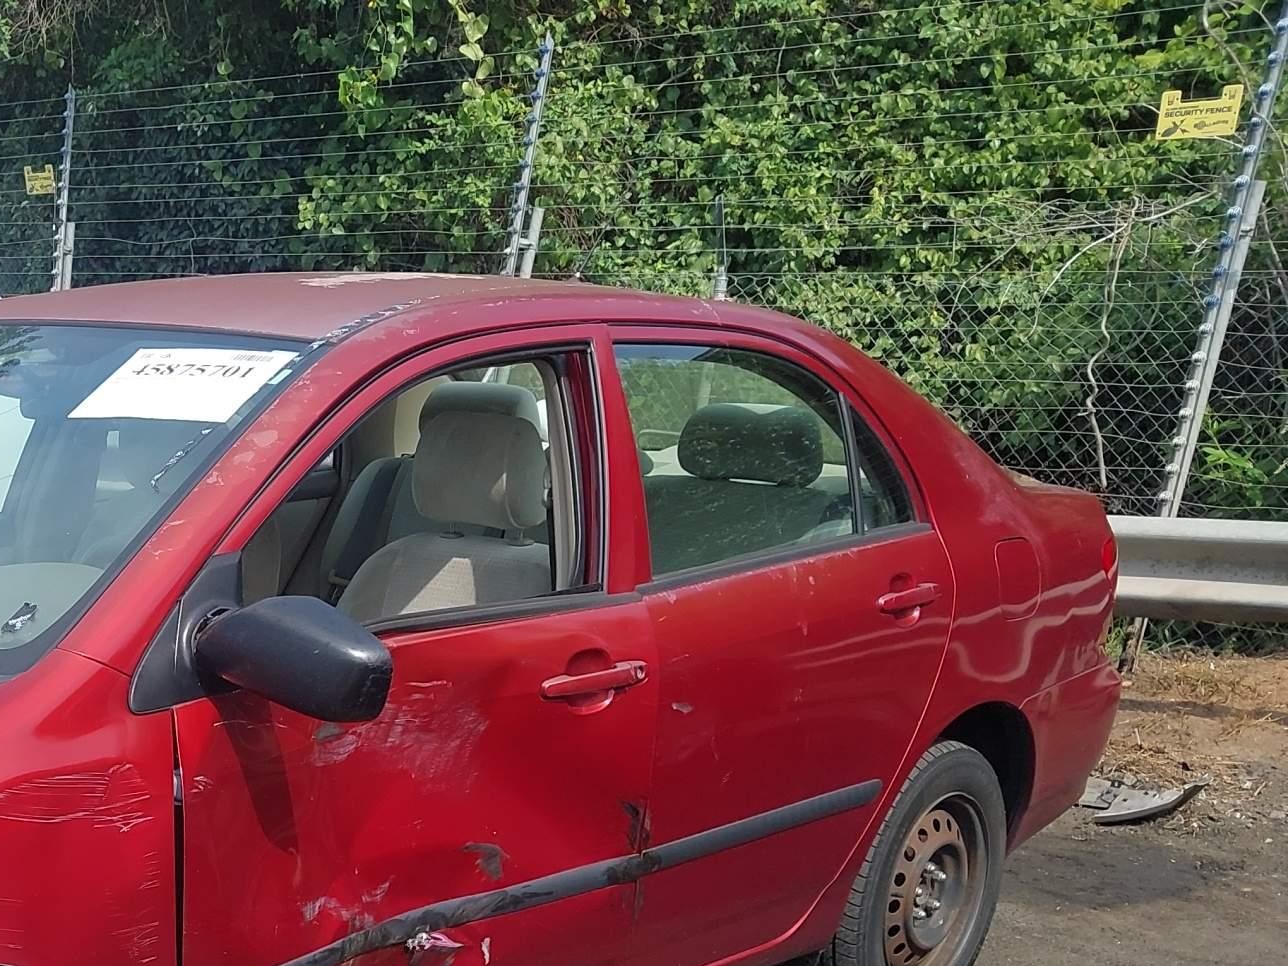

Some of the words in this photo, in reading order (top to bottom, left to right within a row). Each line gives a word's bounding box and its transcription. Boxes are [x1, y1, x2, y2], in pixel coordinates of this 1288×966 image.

[1164, 108, 1204, 118] SECURITY
[1205, 106, 1233, 114] FENCE
[132, 363, 255, 378] 45875701
